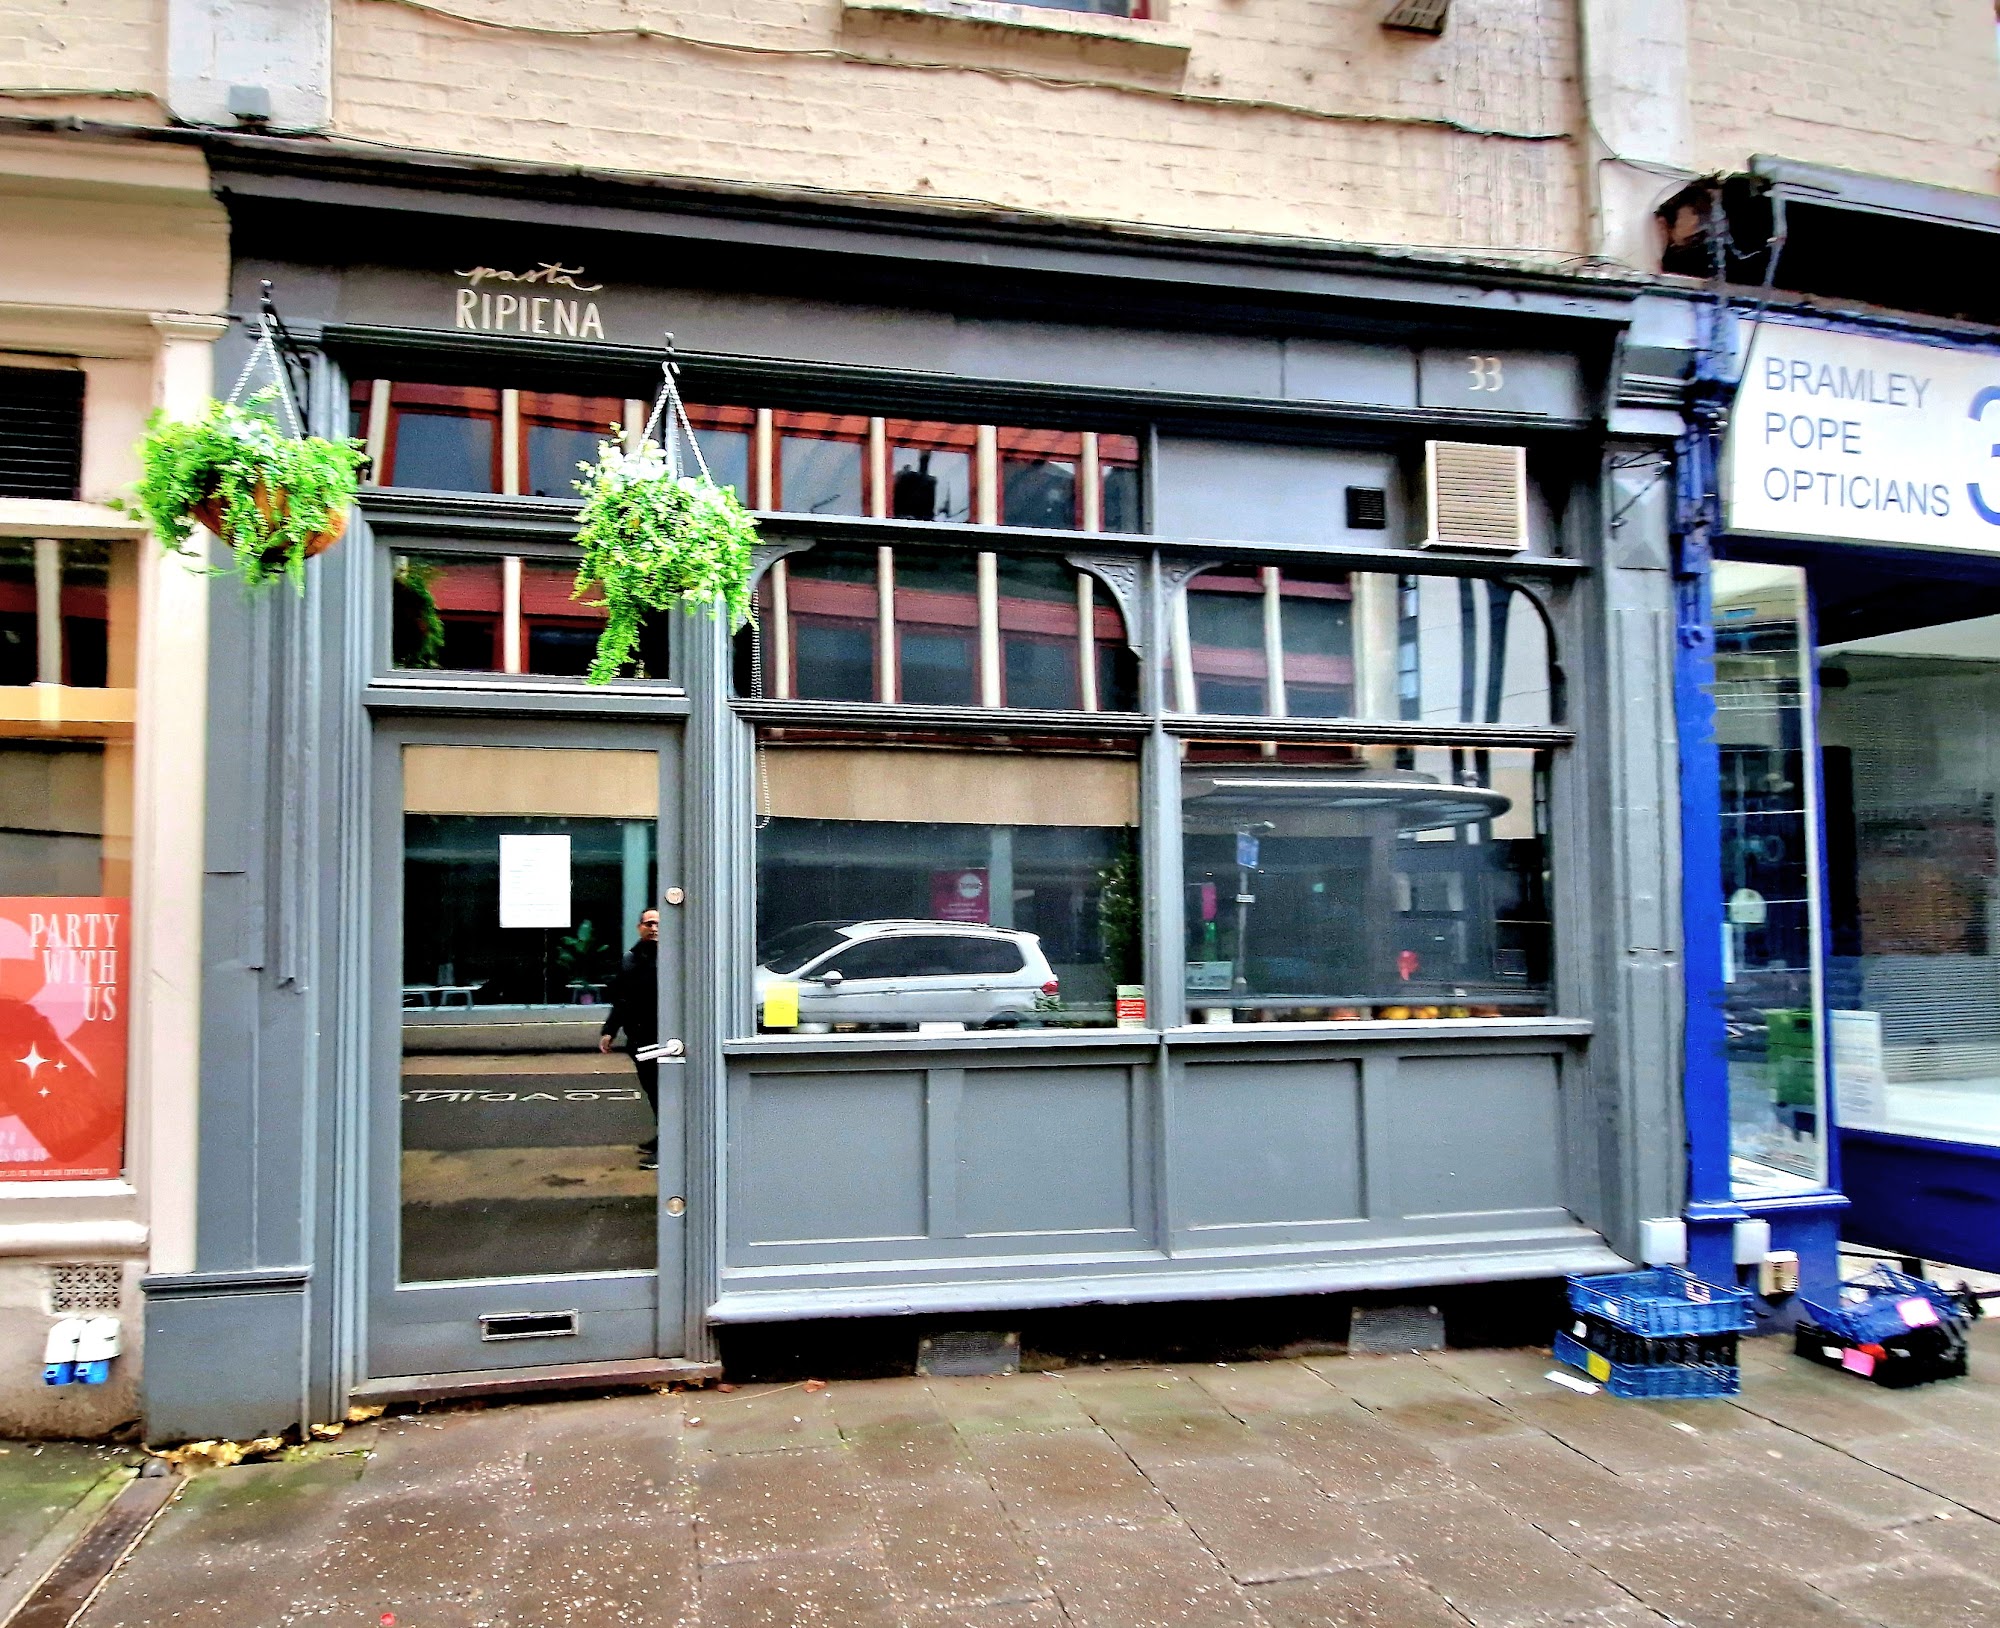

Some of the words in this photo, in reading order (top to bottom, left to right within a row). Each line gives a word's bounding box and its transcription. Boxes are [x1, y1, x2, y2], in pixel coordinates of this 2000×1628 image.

[454, 262, 603, 291] pasta
[456, 288, 605, 339] RIPIENA
[1468, 355, 1504, 392] 33
[1765, 356, 1931, 408] BRAMLEY
[1765, 411, 1862, 454] POPE
[1764, 467, 1949, 517] OPTICIANS
[29, 913, 119, 948] PARTY
[42, 950, 118, 984] WITH
[83, 986, 116, 1021] US
